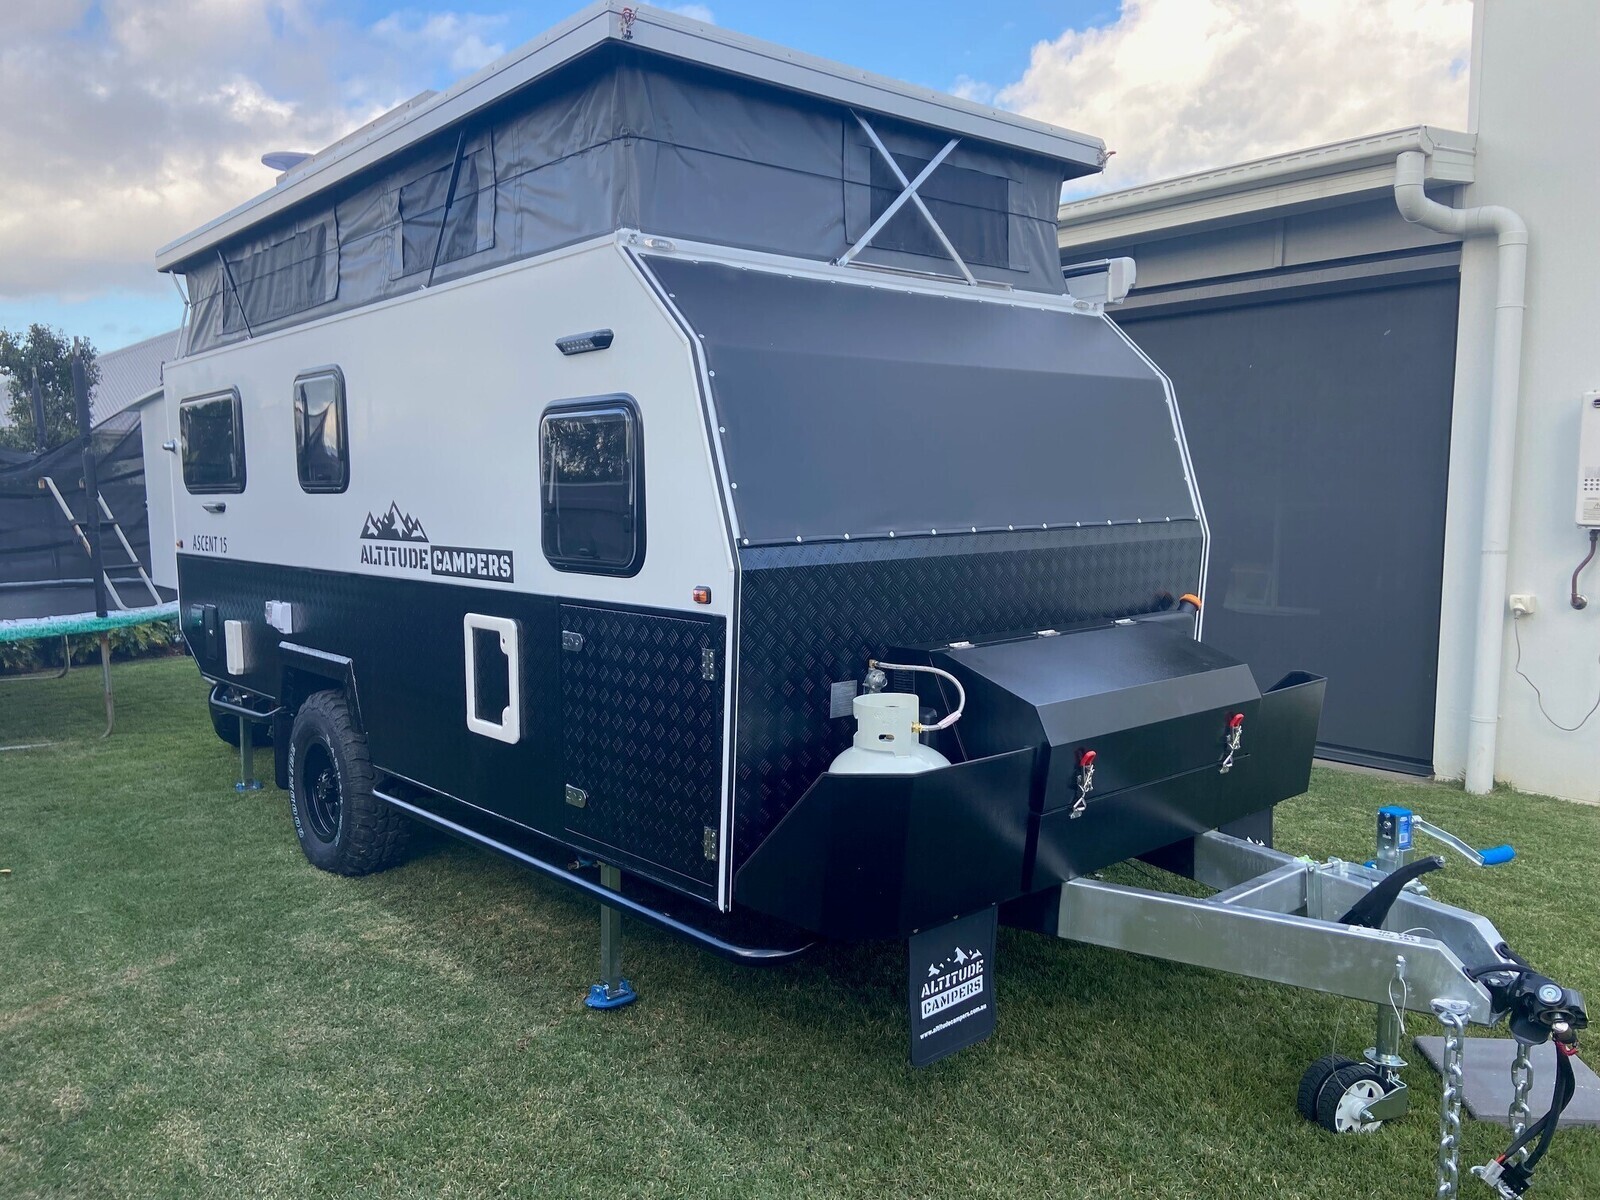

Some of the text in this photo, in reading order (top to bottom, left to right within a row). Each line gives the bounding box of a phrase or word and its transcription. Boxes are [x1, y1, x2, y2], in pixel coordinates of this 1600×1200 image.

[192, 535, 228, 553] ASCENT 15
[361, 544, 511, 577] ALTITUDE CAMPERS
[921, 959, 984, 998] ALTITUDE
[923, 979, 981, 1015] CAMPERS
